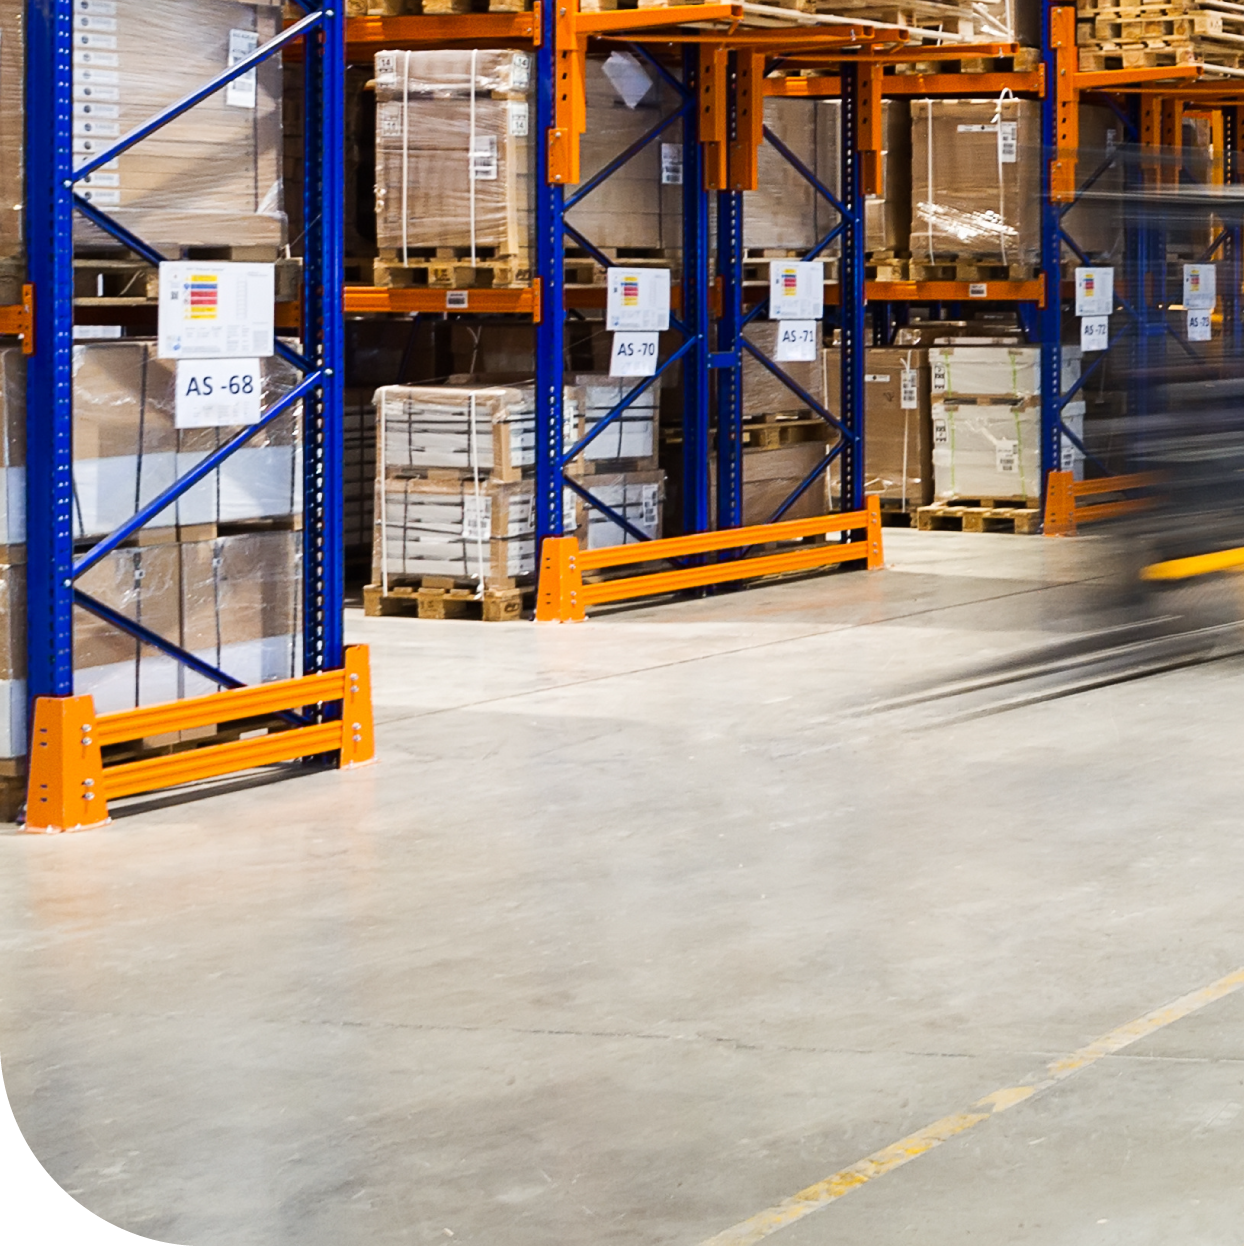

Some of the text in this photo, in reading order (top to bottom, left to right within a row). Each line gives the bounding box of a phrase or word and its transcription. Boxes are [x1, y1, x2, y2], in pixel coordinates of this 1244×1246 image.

[782, 330, 797, 342] AS
[617, 342, 634, 356] AS
[185, 375, 254, 397] AS -68
